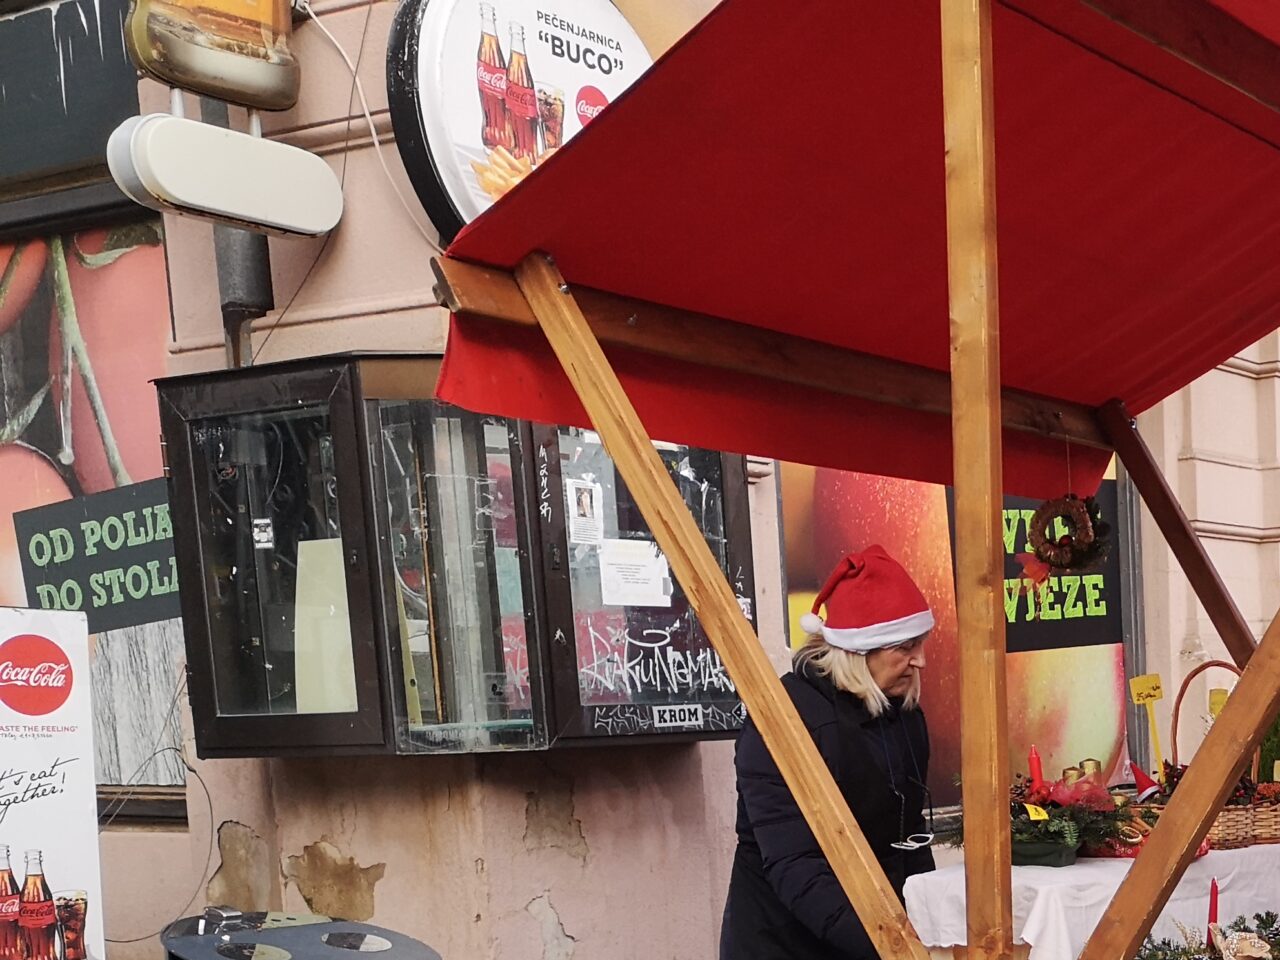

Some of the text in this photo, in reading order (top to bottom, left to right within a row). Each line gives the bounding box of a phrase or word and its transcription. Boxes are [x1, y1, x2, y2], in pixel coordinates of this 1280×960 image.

[536, 10, 623, 53] PEČENJARNICA
[29, 503, 174, 567] OD POLJA
[36, 579, 83, 610] DO
[22, 725, 39, 733] THE
[657, 707, 700, 725] KROM
